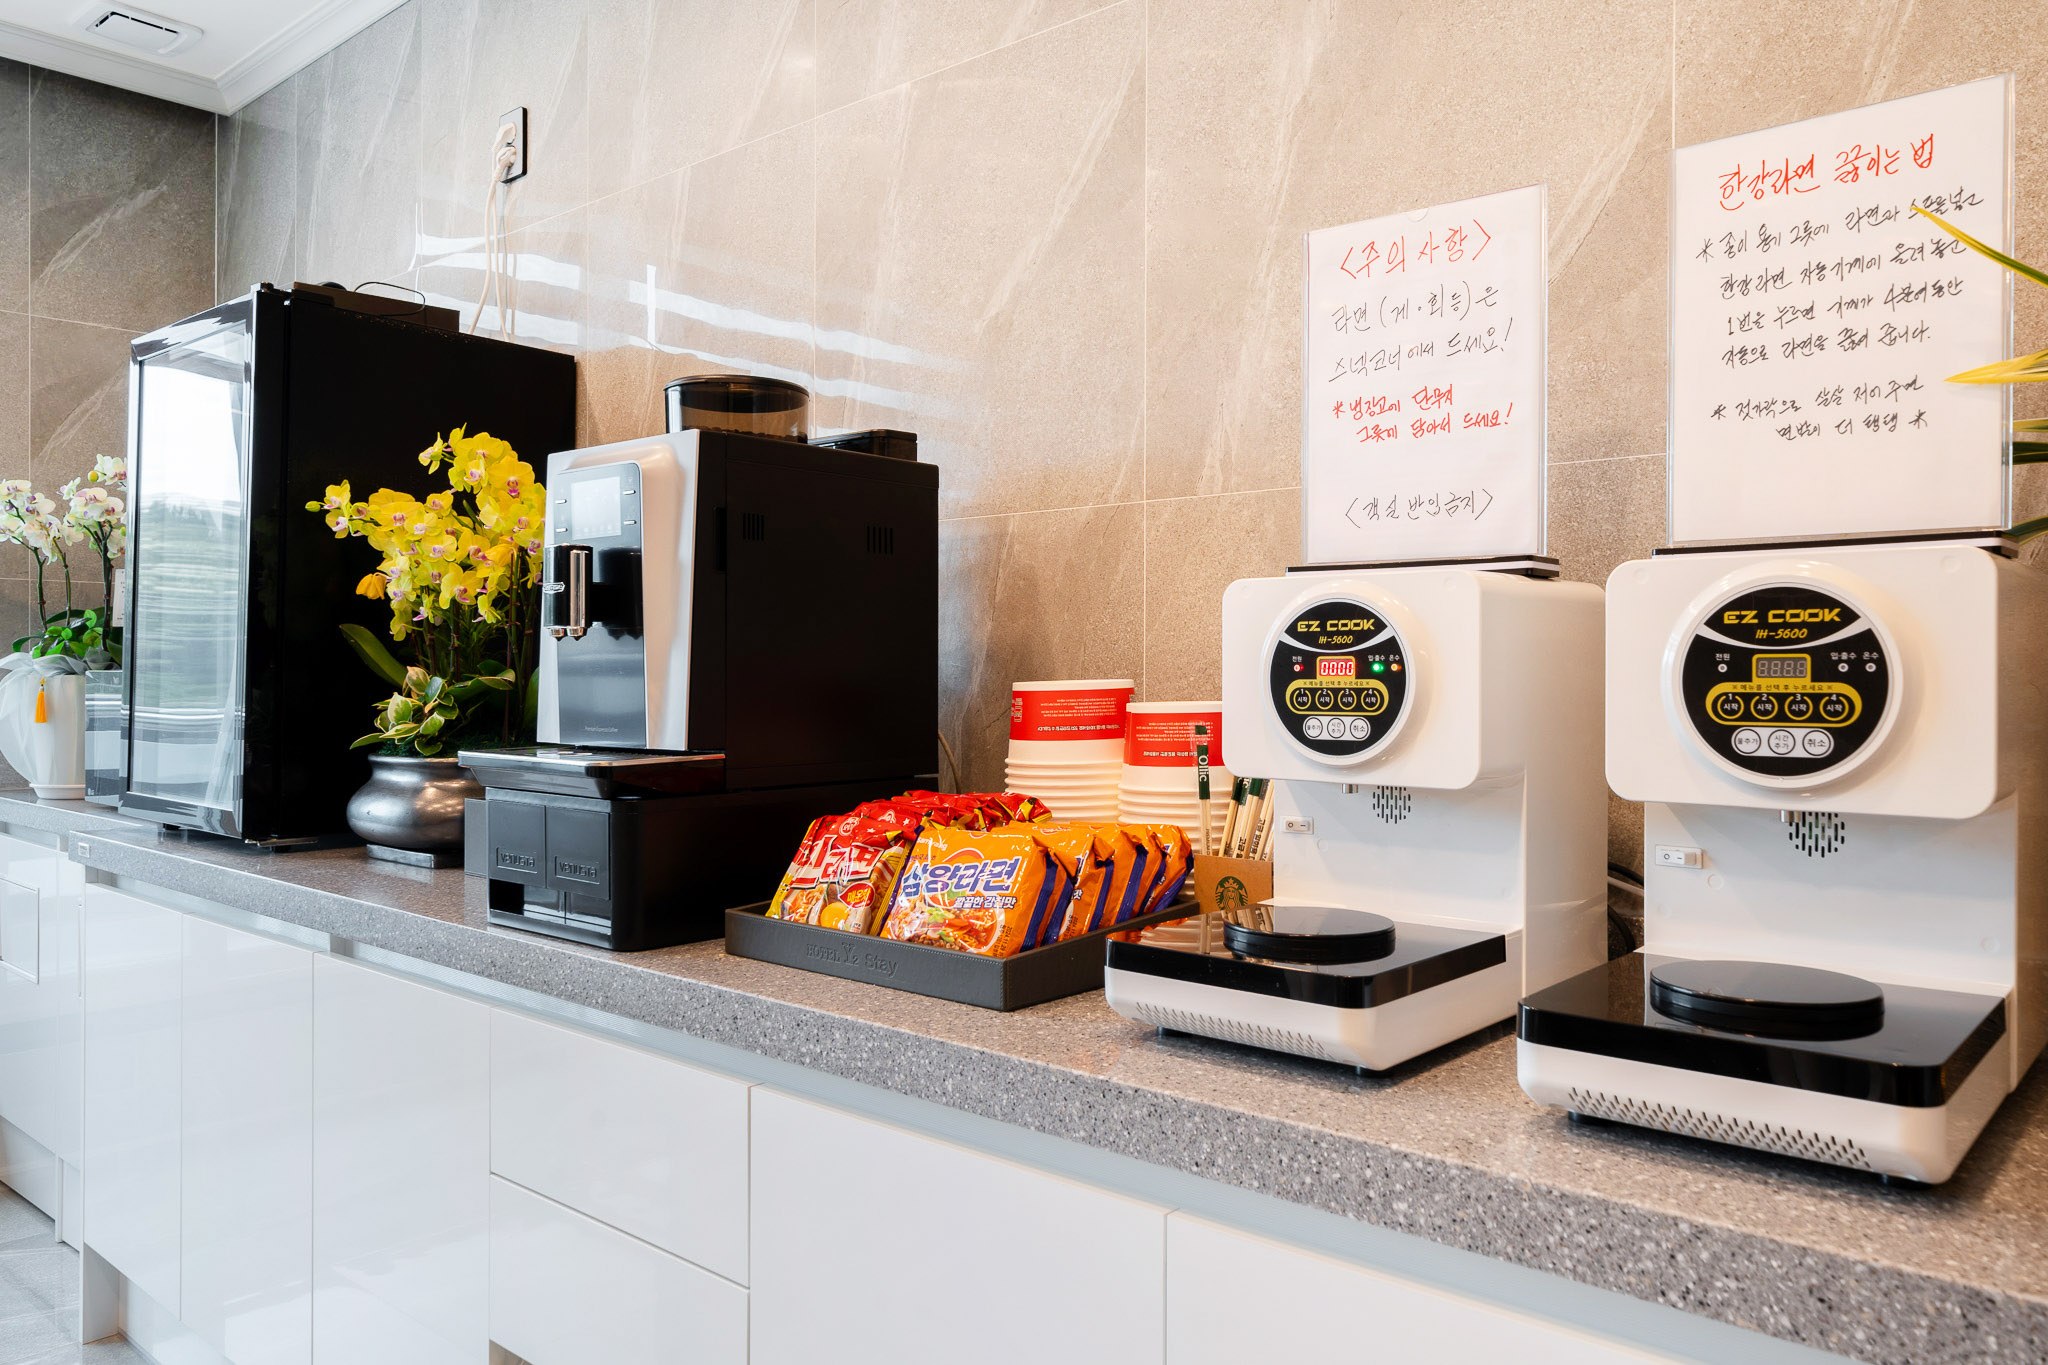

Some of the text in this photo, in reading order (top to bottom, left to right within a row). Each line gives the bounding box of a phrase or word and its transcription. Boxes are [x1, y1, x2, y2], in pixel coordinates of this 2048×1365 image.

[1910, 133, 1935, 169] 법
[1845, 203, 1900, 232] 라면과
[1331, 302, 1371, 334] 라면
[1781, 333, 1829, 360] 라면을
[1411, 384, 1453, 410] 단무지
[1410, 413, 1451, 438] 담아서
[1835, 418, 1852, 434] 더
[1723, 608, 1841, 624] EZ COOK
[1297, 618, 1375, 632] EZ COOK
[1318, 635, 1353, 644] IH-5600
[1755, 628, 1808, 639] IH-5600
[1320, 662, 1353, 675] 0000
[1723, 703, 1739, 711] 시작
[1757, 703, 1772, 711] 시작
[1791, 704, 1807, 712] 시작
[1826, 704, 1843, 712] 시작
[1807, 738, 1826, 748] 취소
[902, 857, 1021, 897] 삼양라면
[807, 943, 841, 964] HOTEL
[864, 953, 899, 978] Stay
